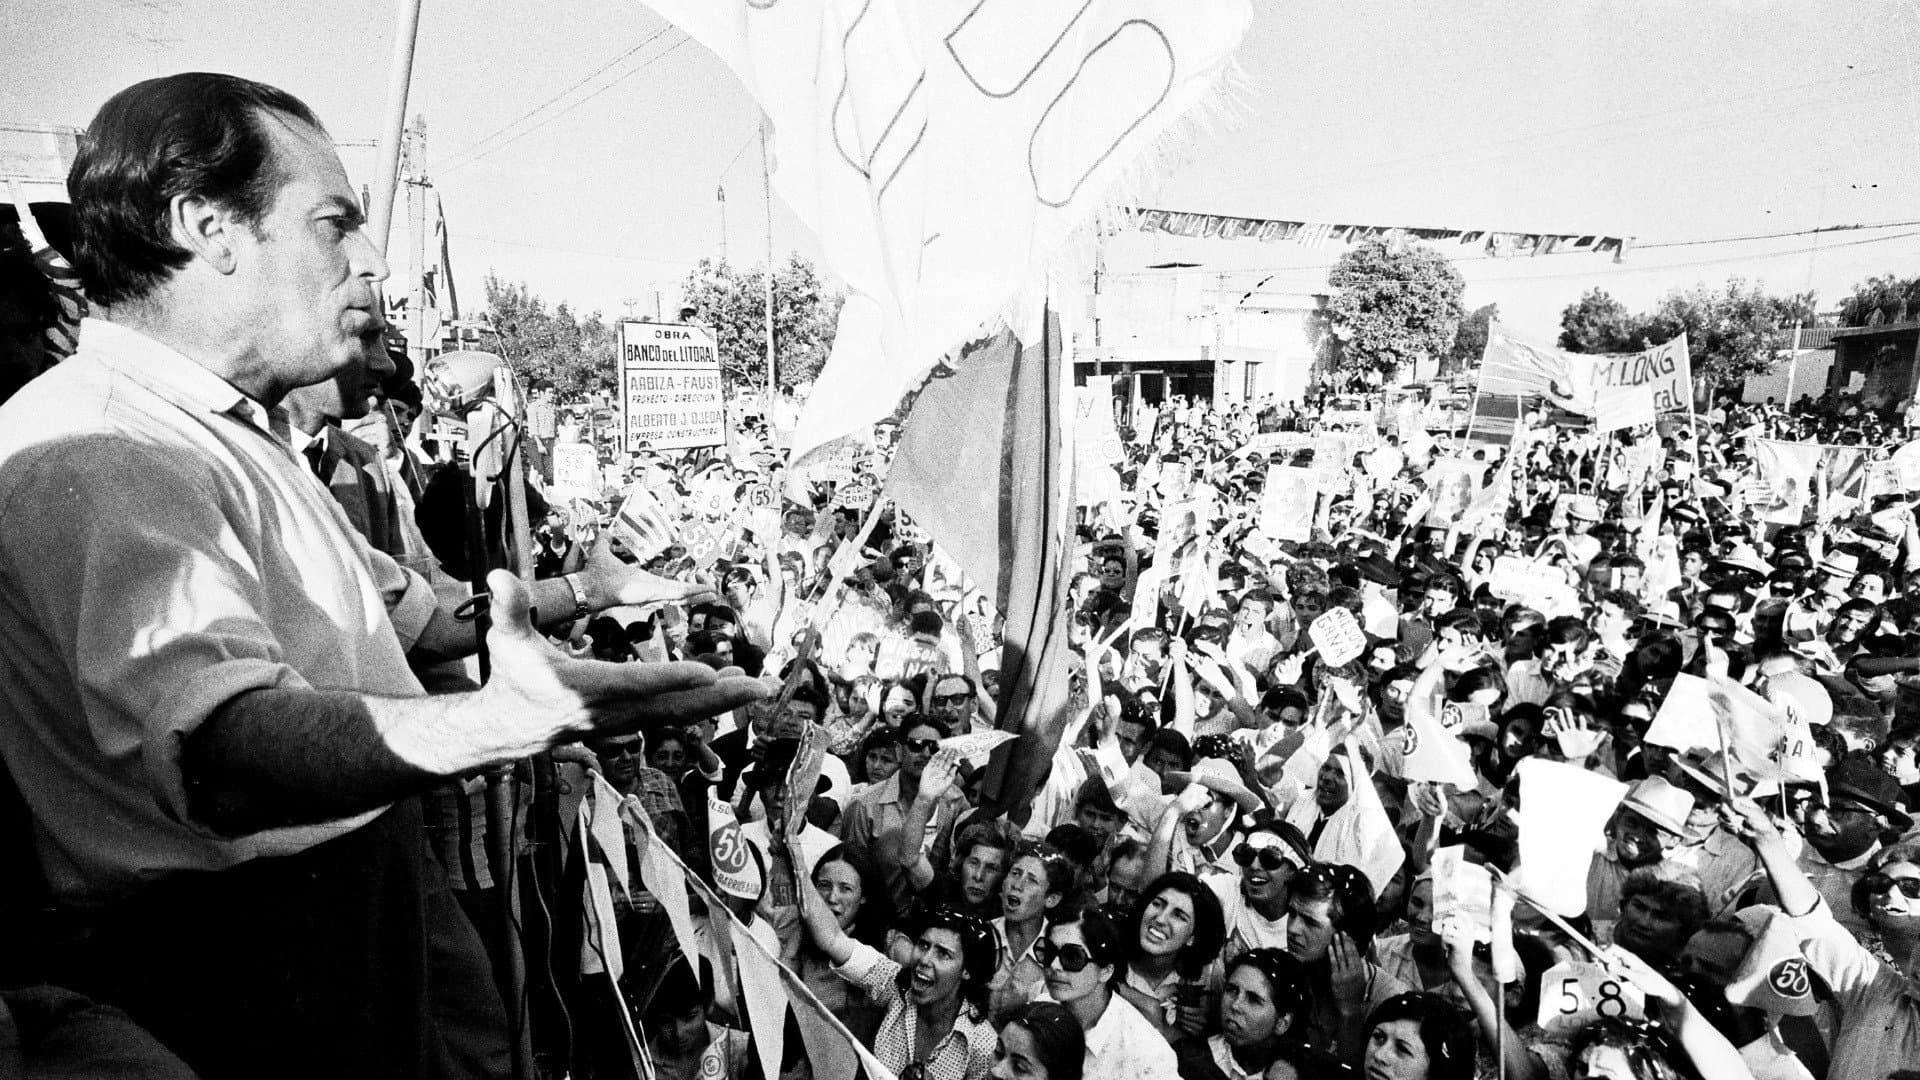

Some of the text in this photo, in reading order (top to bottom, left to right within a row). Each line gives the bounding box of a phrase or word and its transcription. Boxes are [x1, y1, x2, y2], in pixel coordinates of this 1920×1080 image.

[655, 330, 691, 340] OBRA
[627, 344, 717, 363] BANCO DEL LITORAL
[630, 412, 677, 428] ALBERTO
[756, 489, 770, 506] 58
[683, 525, 715, 559] 58
[714, 827, 745, 868] 58
[1776, 960, 1809, 993] 58
